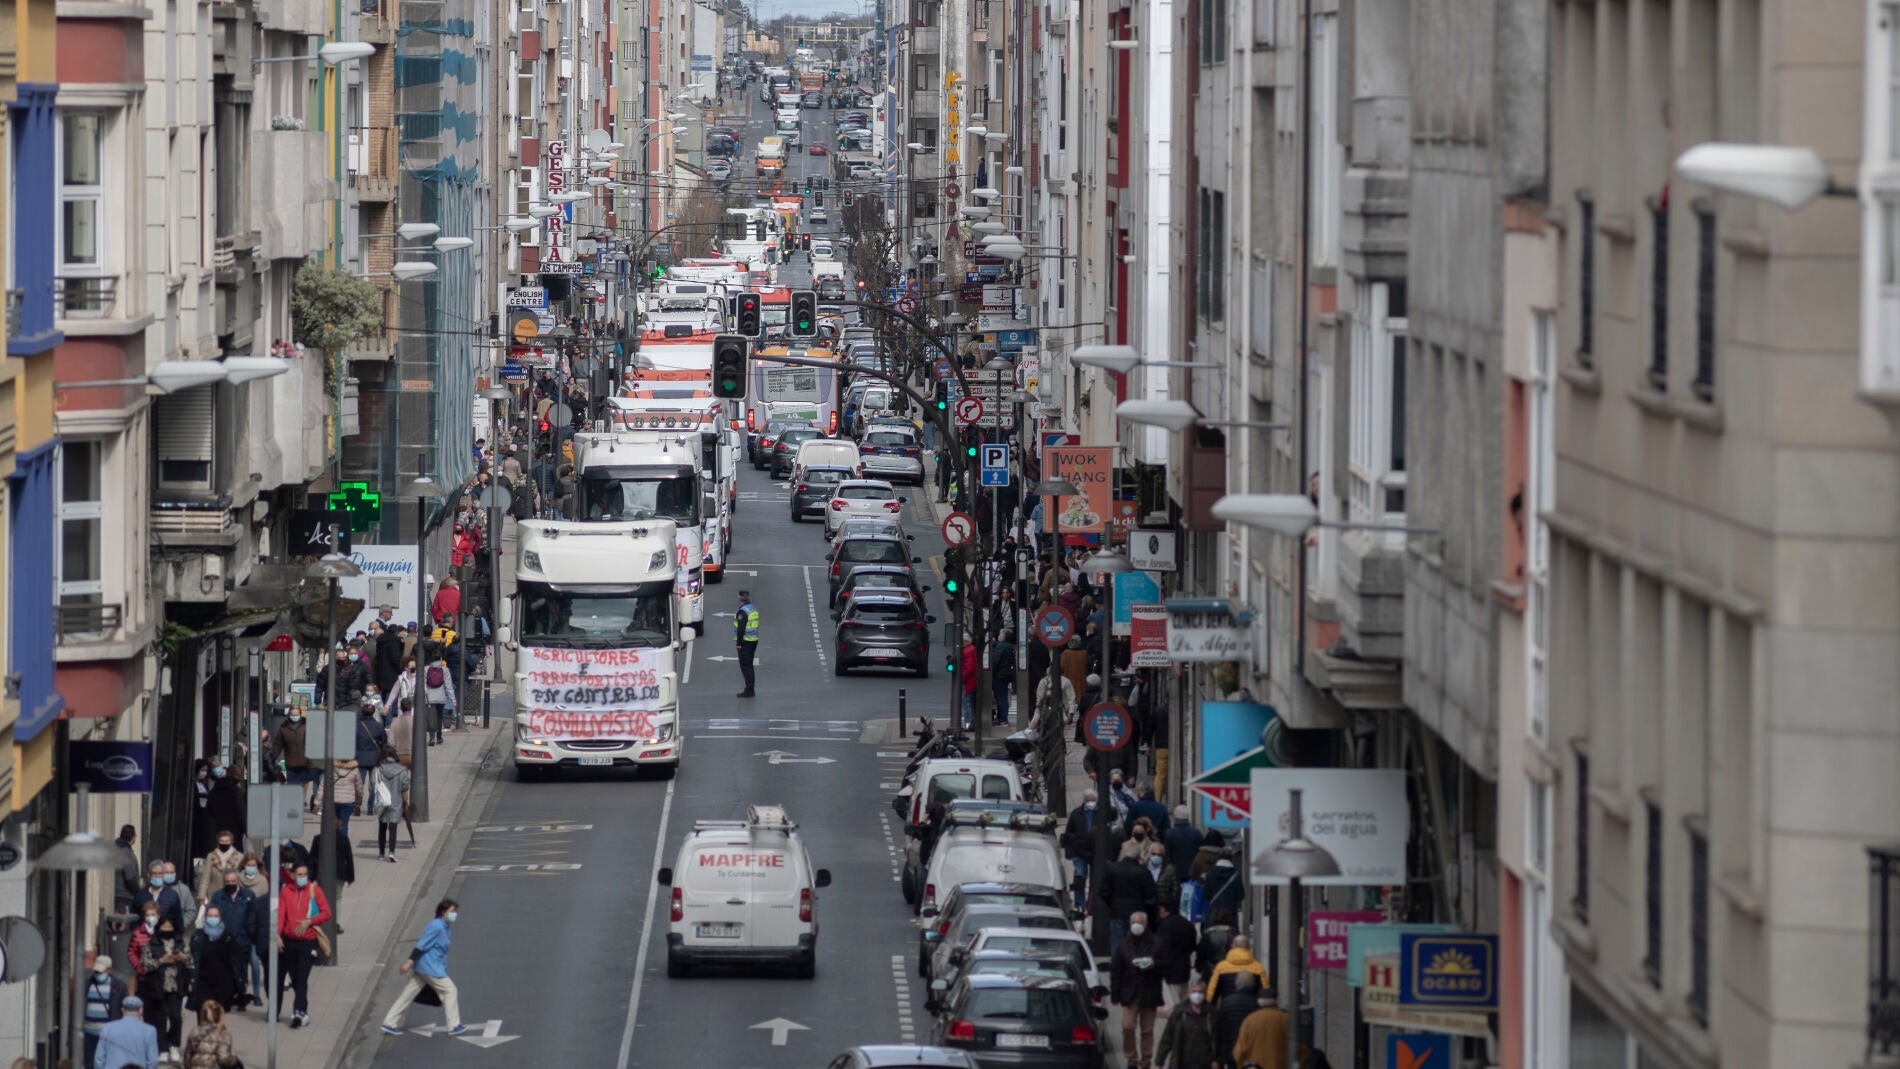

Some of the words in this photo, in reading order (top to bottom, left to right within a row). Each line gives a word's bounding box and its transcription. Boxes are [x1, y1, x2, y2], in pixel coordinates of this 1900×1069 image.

[989, 450, 1002, 465] P
[1059, 455, 1096, 464] WOK
[533, 648, 639, 666] AGRICULTORES
[580, 663, 590, 674] E
[528, 669, 657, 687] TRANSPORTISTAS
[532, 688, 560, 703] EN
[564, 686, 637, 705] CONTRA
[530, 708, 660, 738] COMUNISTAS
[1311, 823, 1335, 835] del
[1339, 825, 1377, 839] agua
[699, 854, 784, 867] MAPFRE
[728, 870, 767, 878] Cuidamos
[1369, 965, 1392, 988] H
[1422, 976, 1480, 991] OCASO
